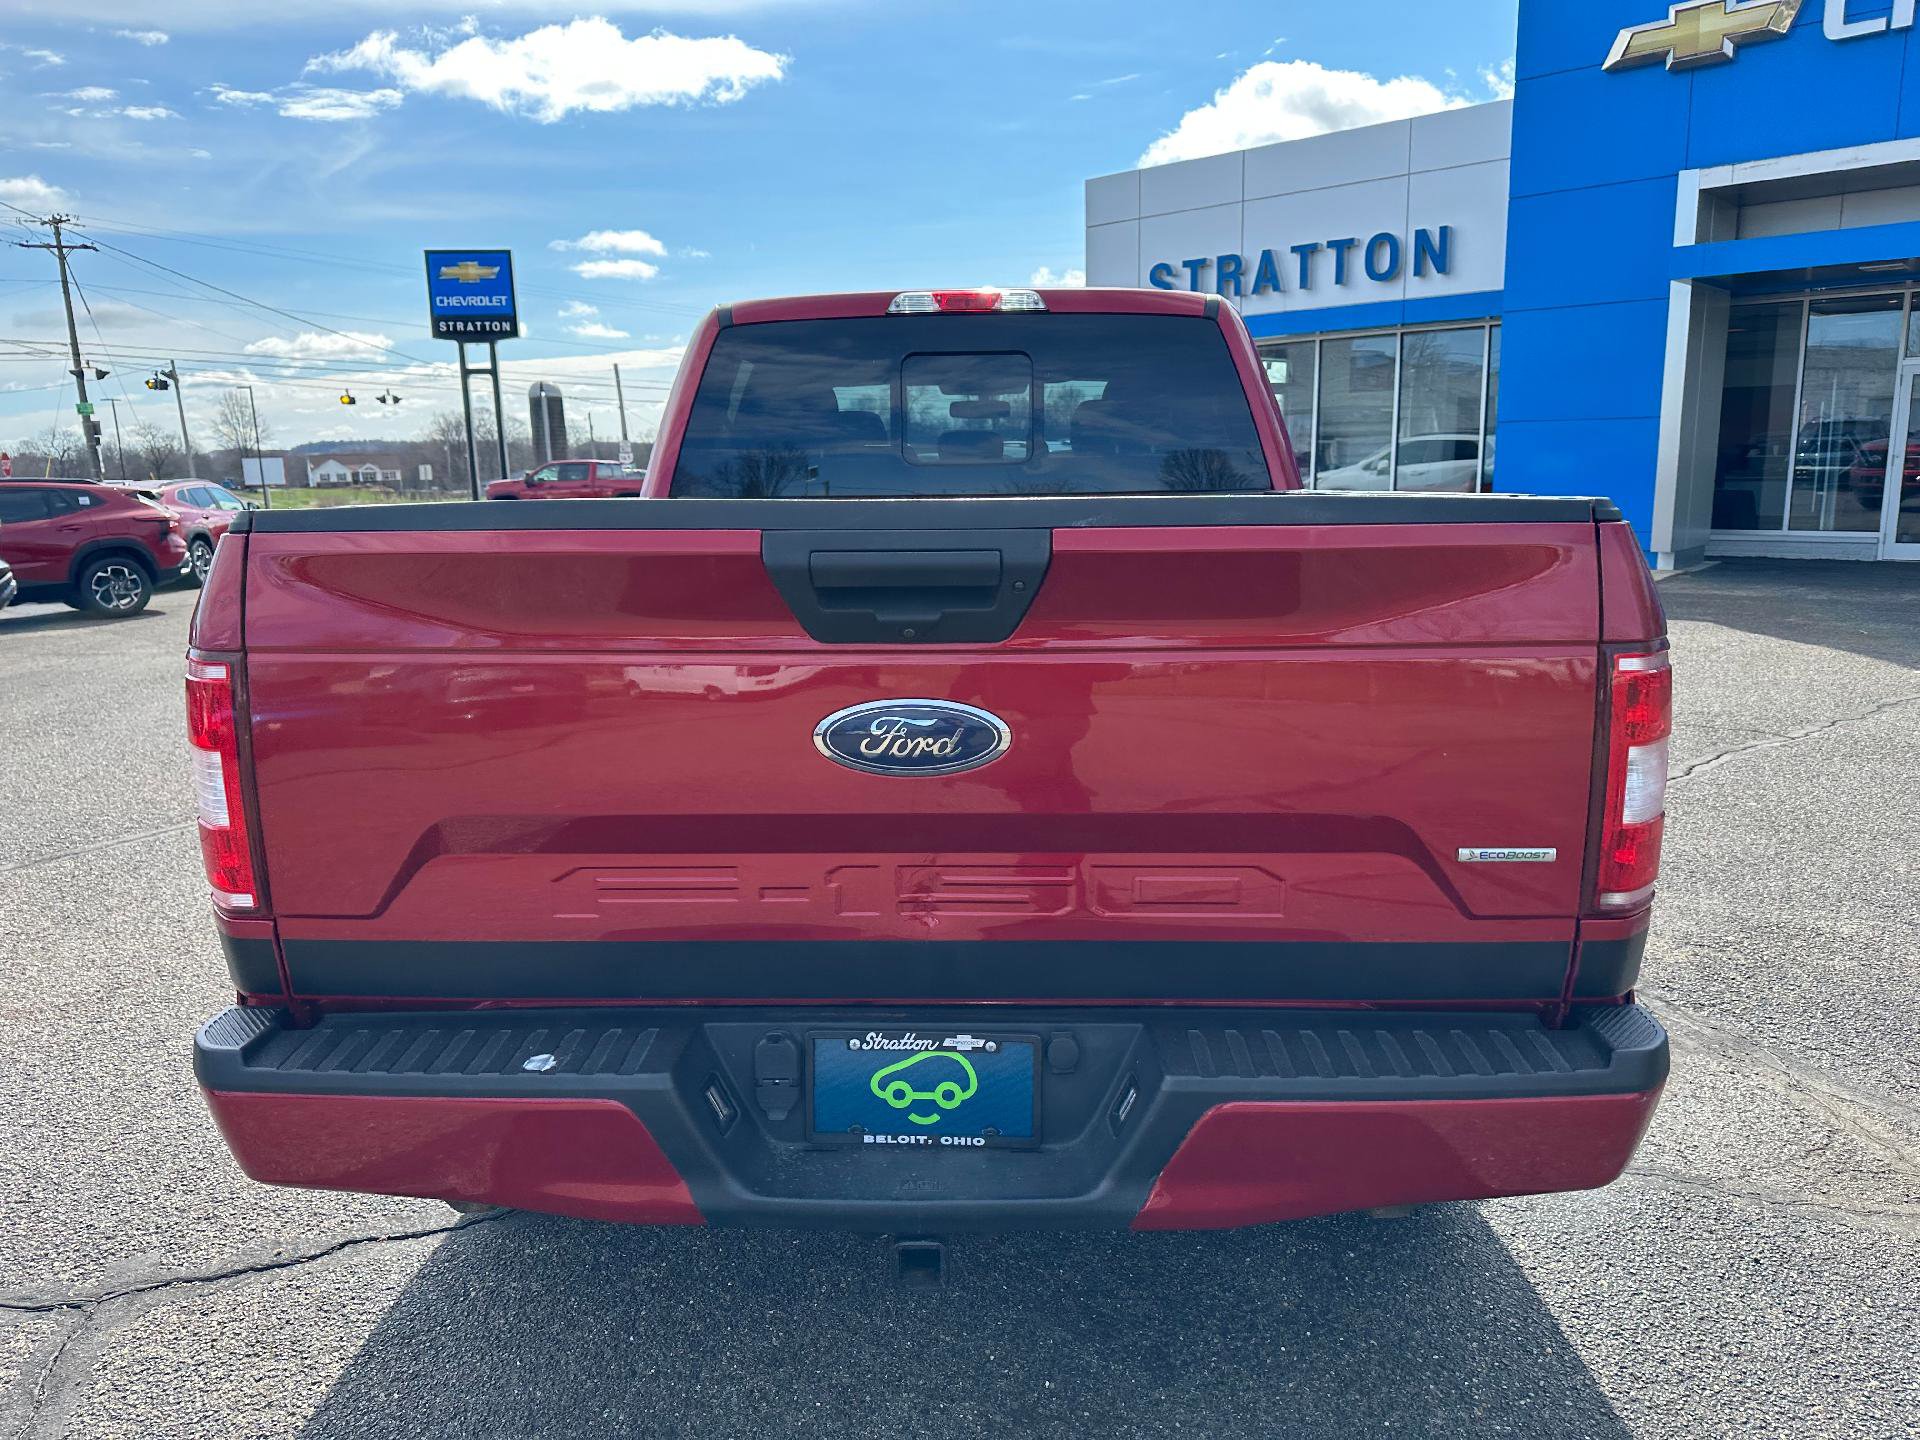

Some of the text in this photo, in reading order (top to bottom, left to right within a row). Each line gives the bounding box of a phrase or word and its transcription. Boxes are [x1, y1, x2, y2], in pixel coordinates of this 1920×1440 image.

[1149, 225, 1454, 297] STRATTON
[435, 295, 508, 307] CHEVROLET
[439, 321, 511, 332] STRATTON
[860, 716, 964, 758] Ford
[861, 1031, 939, 1050] Stratton
[863, 1134, 986, 1147] BELOIT, OHIO
